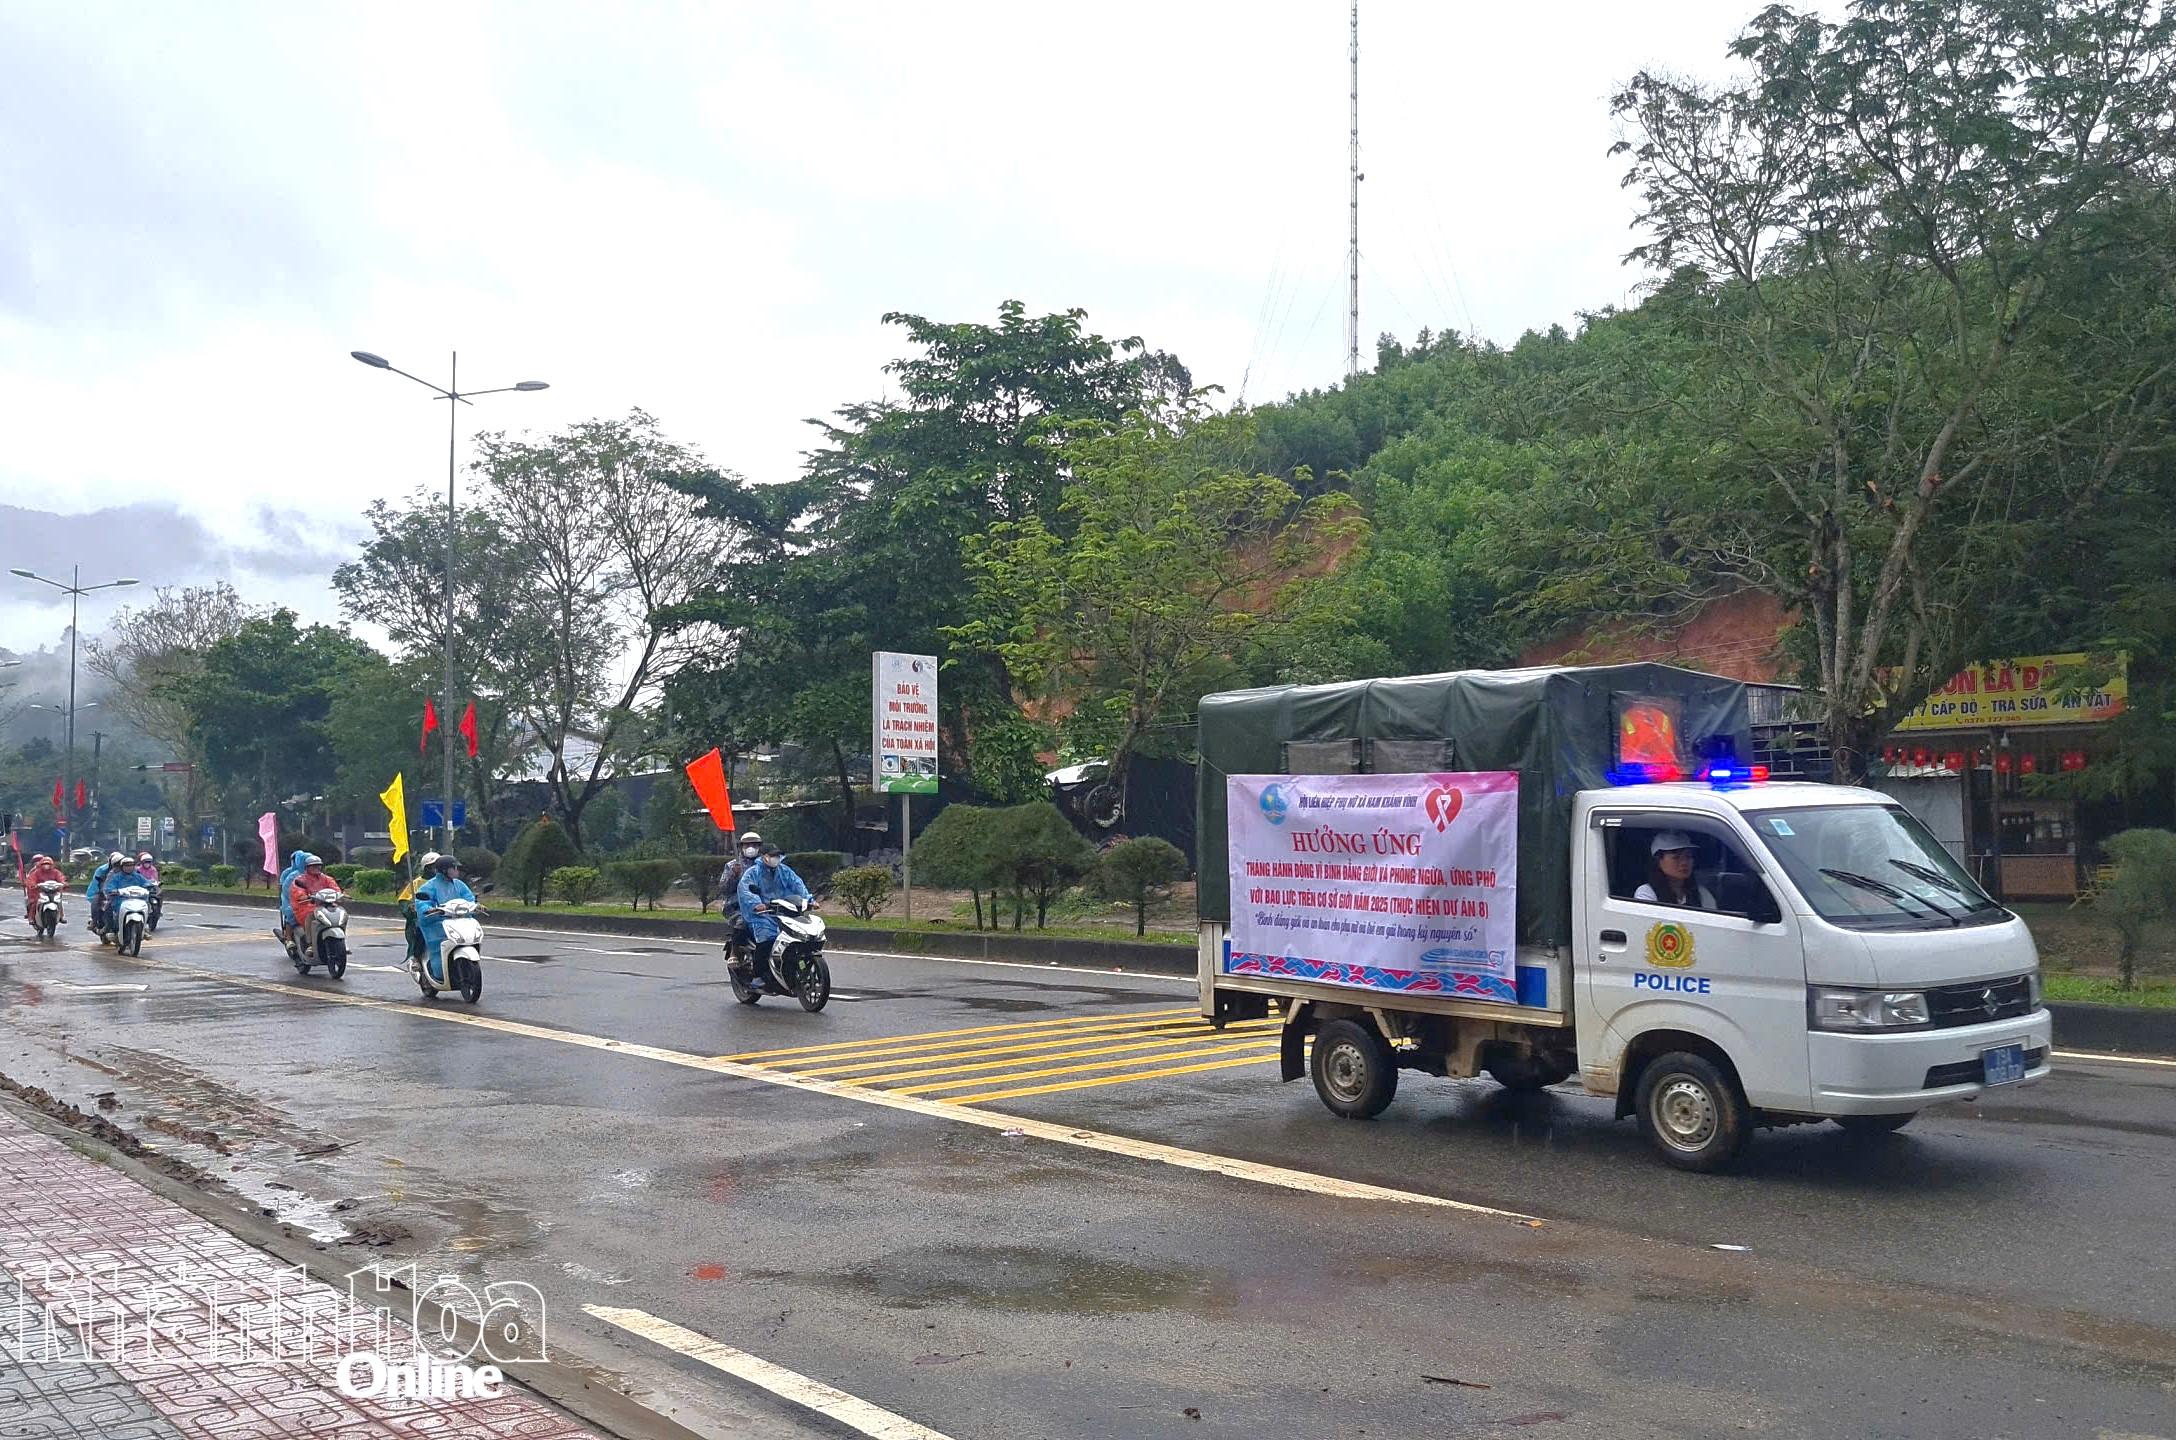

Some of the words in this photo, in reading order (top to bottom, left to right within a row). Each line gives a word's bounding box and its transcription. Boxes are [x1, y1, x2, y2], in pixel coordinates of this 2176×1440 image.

[897, 681, 910, 695] BẢO
[911, 683, 920, 699] VỆ
[889, 700, 901, 713] MÔI
[903, 700, 928, 714] TRƯỜNG
[1932, 699, 1956, 716] CẤP
[1991, 697, 2016, 713] TRÀ
[2020, 695, 2048, 711] SỮA
[882, 717, 890, 730] LÀ
[892, 719, 912, 731] TRÁCH
[914, 720, 935, 734] NHIỆM
[882, 734, 895, 748] CỦA
[896, 736, 912, 750] TOÀN
[925, 738, 936, 752] HỘI
[1366, 796, 1380, 808] NAM
[1381, 794, 1403, 808] KHÁNH
[1291, 824, 1366, 854] HƯỞNG
[1372, 827, 1421, 855] ỨNG
[1246, 859, 1270, 877] THÁNG
[1272, 859, 1293, 878] HÀNH
[1294, 860, 1314, 881] ĐỘNG
[1315, 861, 1322, 879] VÌ
[1324, 861, 1340, 880] BÌNH
[1342, 858, 1362, 881] ĐẲNG
[1363, 864, 1378, 882] GIỚI
[1379, 864, 1388, 882] VÀ
[1390, 864, 1416, 884] PHÒNG
[1418, 865, 1448, 887] NGỪA,
[1450, 867, 1473, 886] ỨNG
[1476, 868, 1496, 888] PHÓ
[1250, 886, 1263, 903] VỚI
[1265, 889, 1280, 907] BẠO
[1282, 889, 1297, 908] LỰC
[1298, 888, 1316, 907] TRÊN
[1317, 890, 1327, 907] CƠ
[1328, 888, 1338, 908] SỞ
[1339, 890, 1353, 909] GIỚI
[1353, 892, 1370, 910] NĂM
[1371, 896, 1388, 912] 2025
[1390, 896, 1413, 917] (THỰC
[1415, 896, 1440, 919] HIỆN
[1443, 899, 1458, 919] DỰ
[1461, 897, 1475, 917] ÁN
[1479, 901, 1488, 919] 8)
[1274, 911, 1289, 930] đẳng
[1397, 924, 1416, 941] trong
[1417, 924, 1427, 942] kỷ
[1430, 926, 1460, 942] nguyên
[1634, 973, 1710, 993] POLICE
